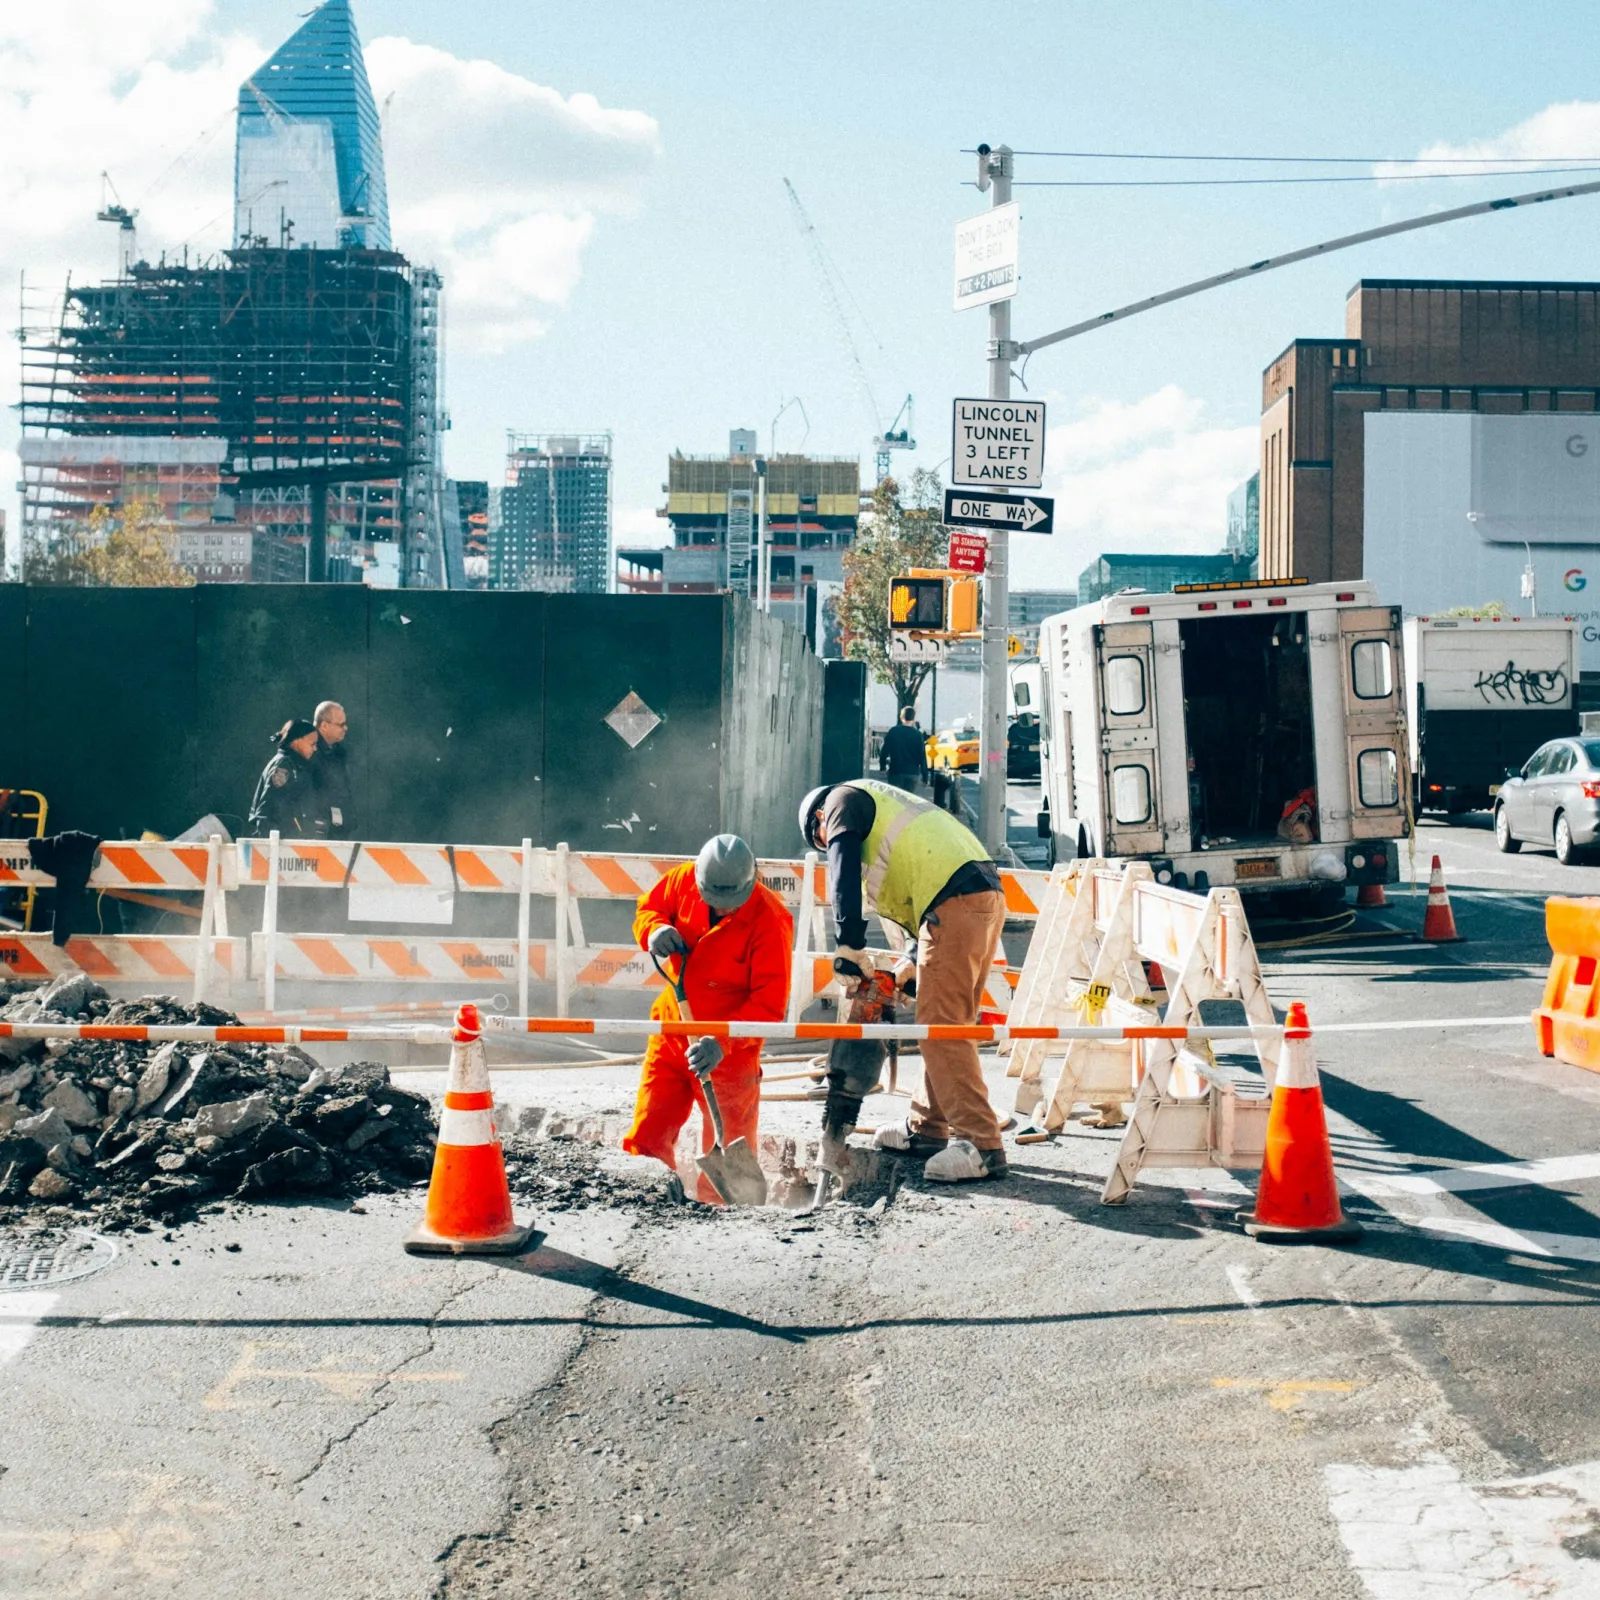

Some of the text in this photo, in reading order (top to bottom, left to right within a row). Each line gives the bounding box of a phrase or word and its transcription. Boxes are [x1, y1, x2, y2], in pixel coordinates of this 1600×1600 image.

[986, 215, 1015, 239] BLOCK
[968, 246, 984, 262] THE
[987, 265, 1014, 288] POINTS
[961, 406, 1037, 423] LINCOLN
[964, 426, 1034, 442] TUNNEL
[966, 444, 1030, 460] 3 LEFT
[968, 464, 1028, 480] LANES
[960, 502, 1037, 522] ONE WAY
[952, 536, 985, 548] NO STANDING
[955, 547, 980, 558] ANYTIME
[1564, 569, 1587, 592] G
